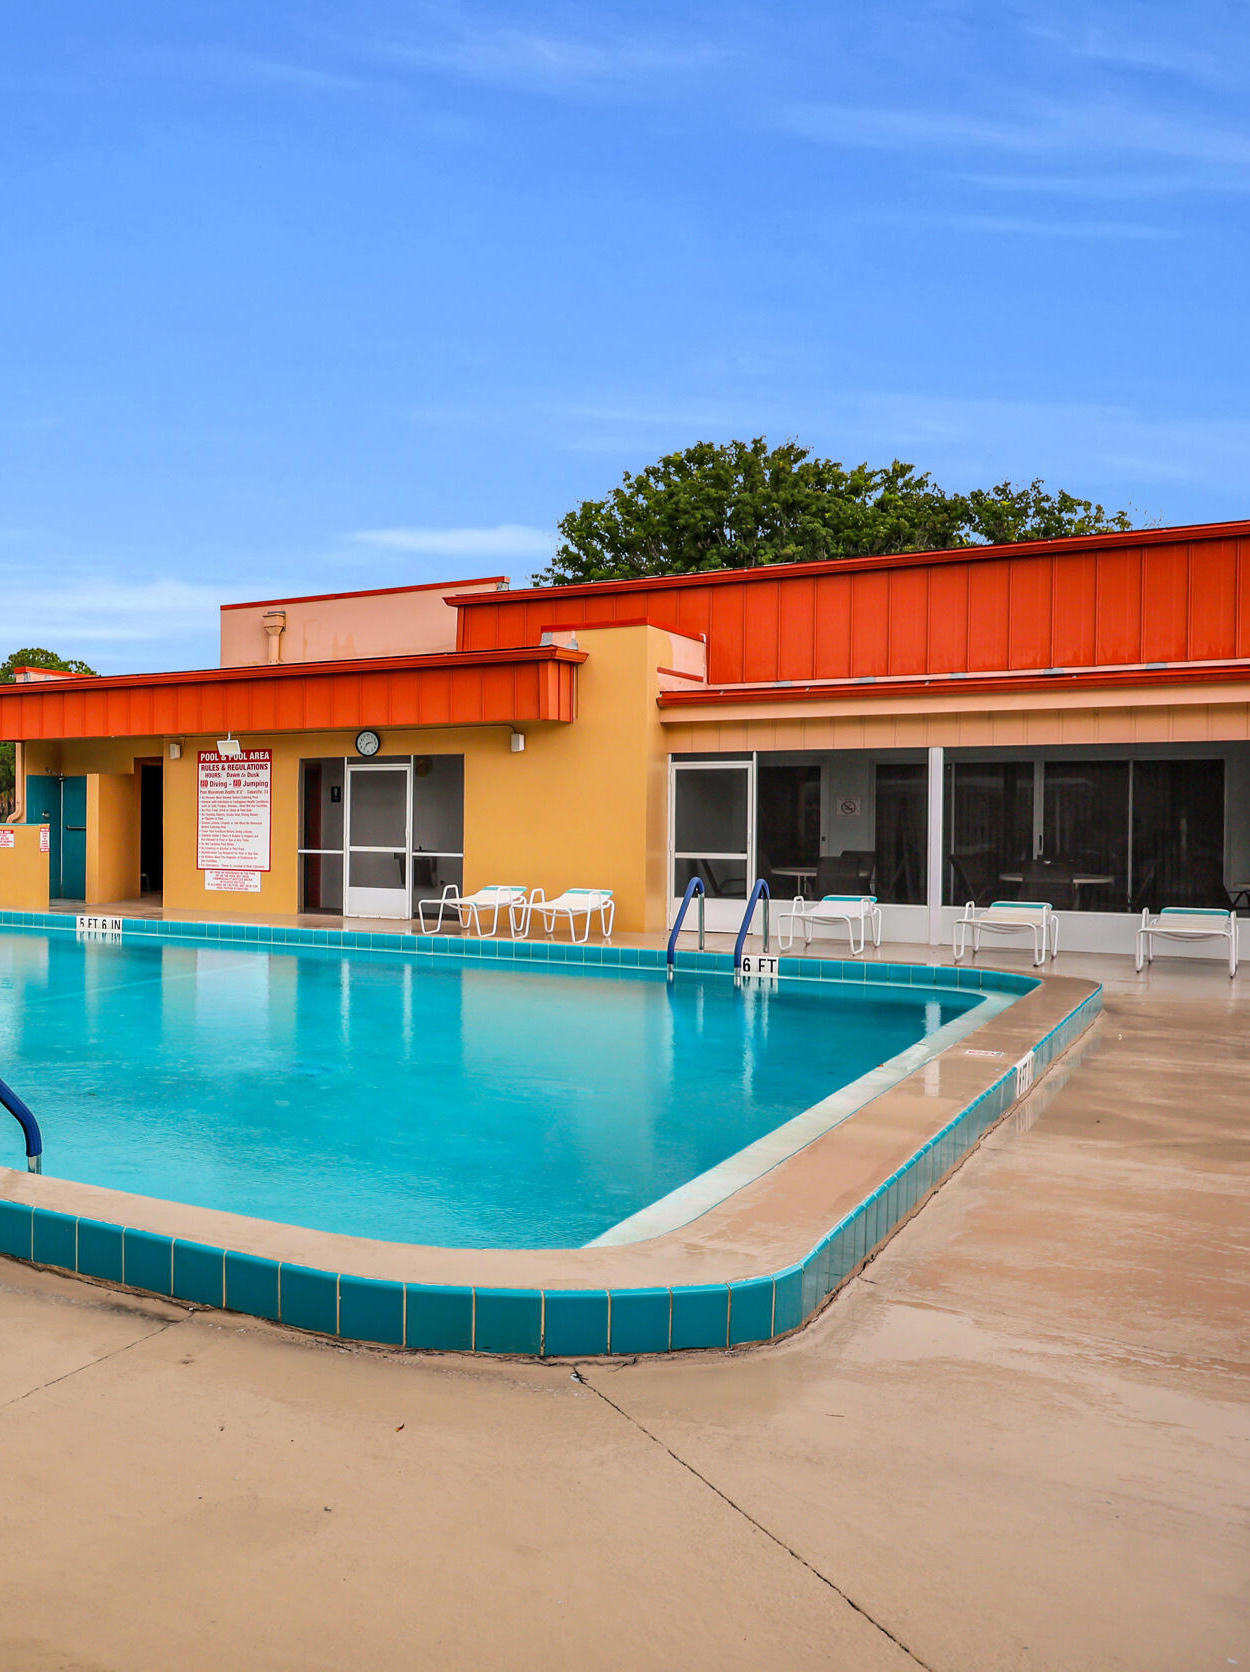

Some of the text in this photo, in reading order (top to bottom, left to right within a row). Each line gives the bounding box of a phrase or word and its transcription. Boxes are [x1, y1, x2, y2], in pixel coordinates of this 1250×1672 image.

[200, 752, 219, 761] POOL
[249, 751, 270, 760] AREA
[227, 763, 269, 771] REGULATIONS
[210, 781, 228, 789] Diving
[233, 779, 242, 787] NO
[243, 780, 269, 789] Jumping
[80, 918, 121, 930] 5 FT 6 IN
[742, 957, 777, 973] 6 FT
